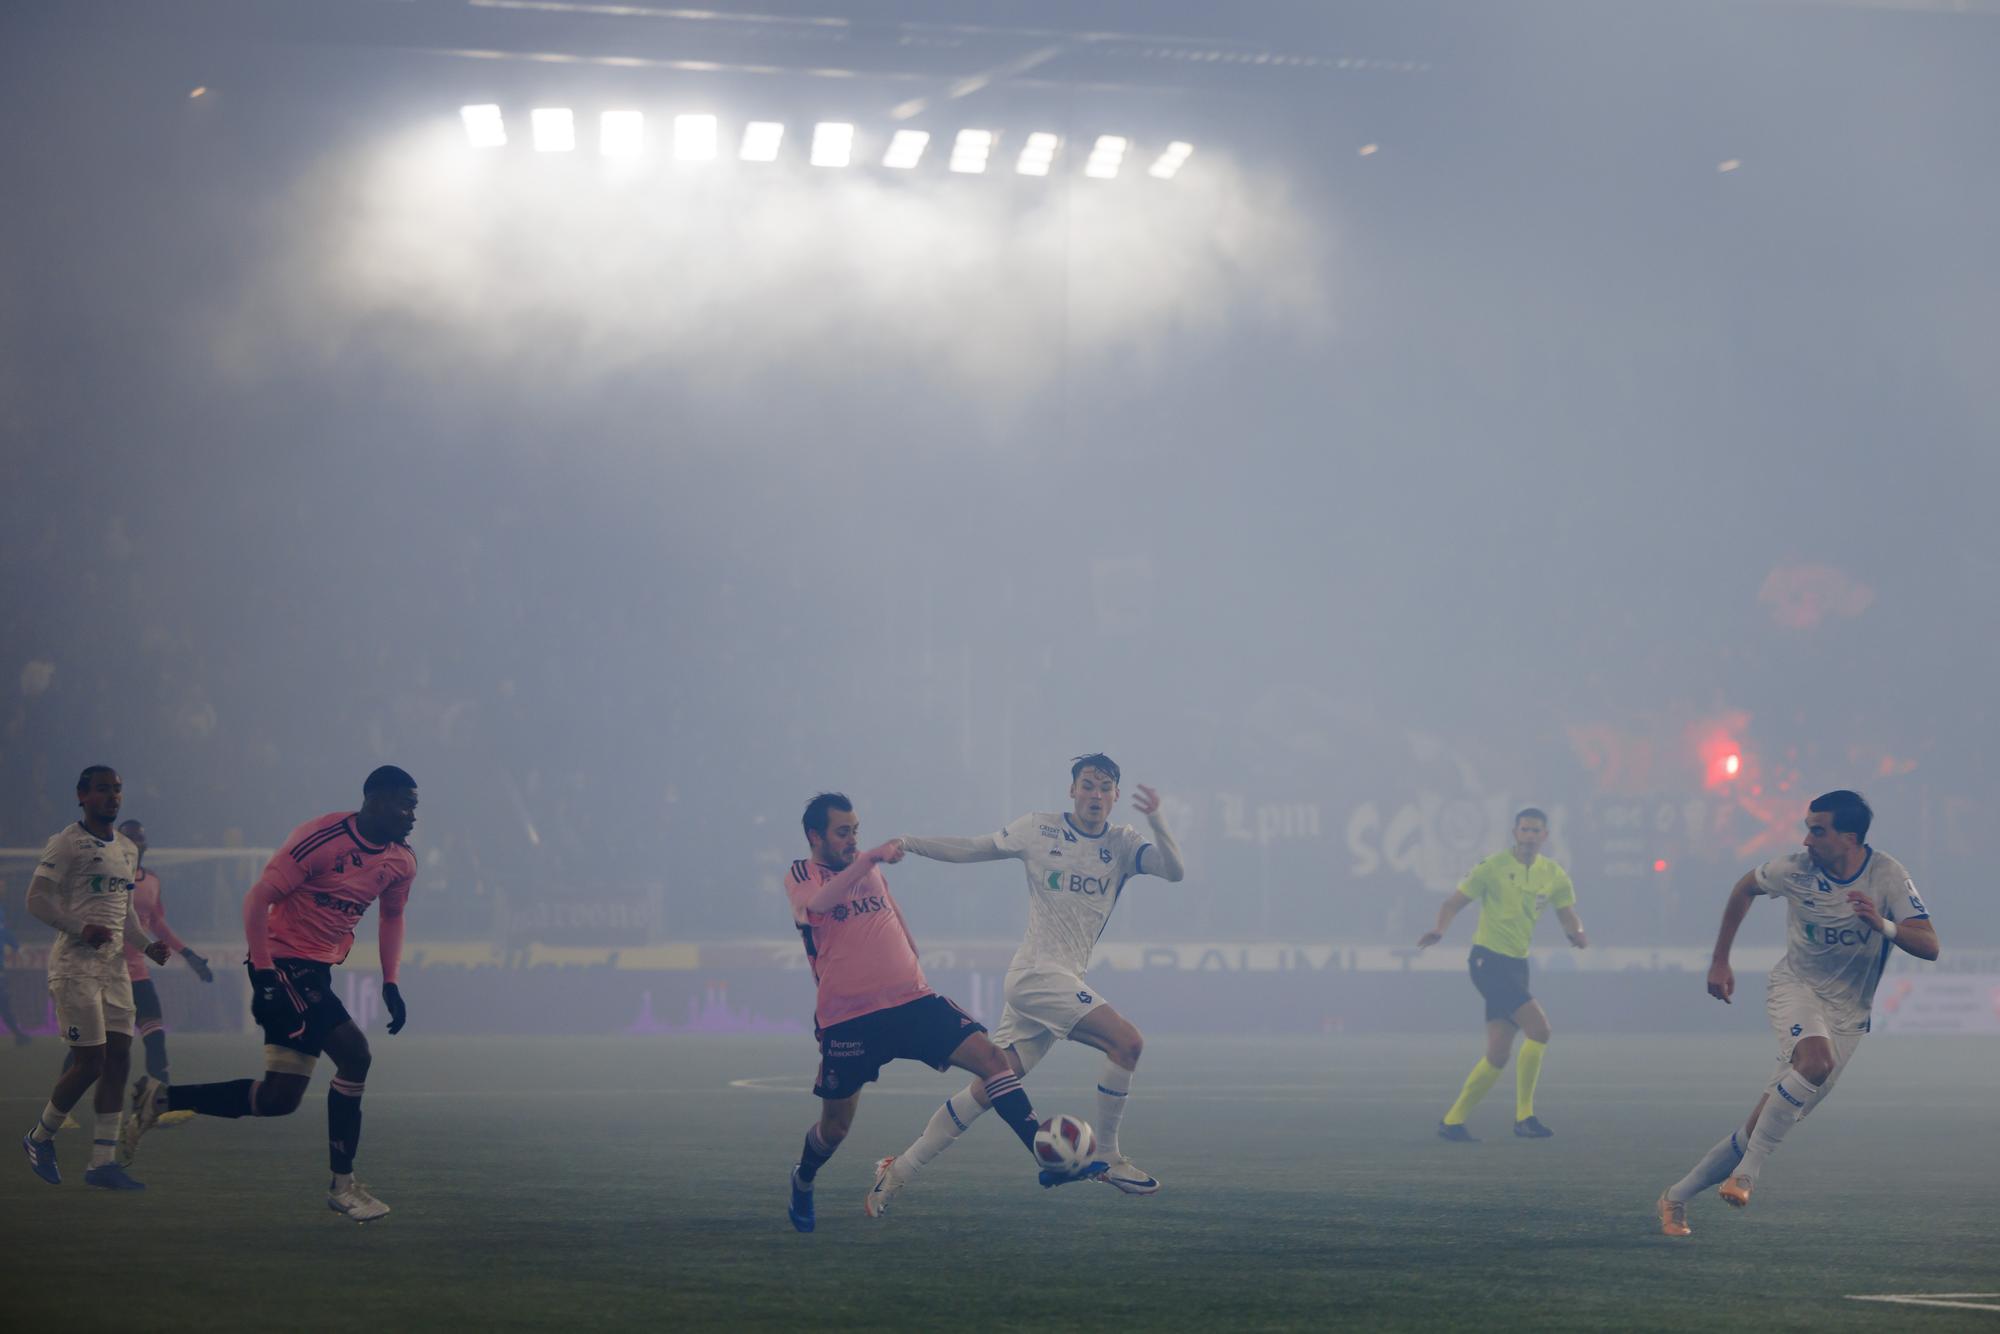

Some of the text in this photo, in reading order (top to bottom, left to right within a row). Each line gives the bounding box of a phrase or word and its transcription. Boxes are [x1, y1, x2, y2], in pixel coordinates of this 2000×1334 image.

[109, 877, 129, 893] BC
[1070, 874, 1111, 895] BCV
[1824, 927, 1873, 946] BCV
